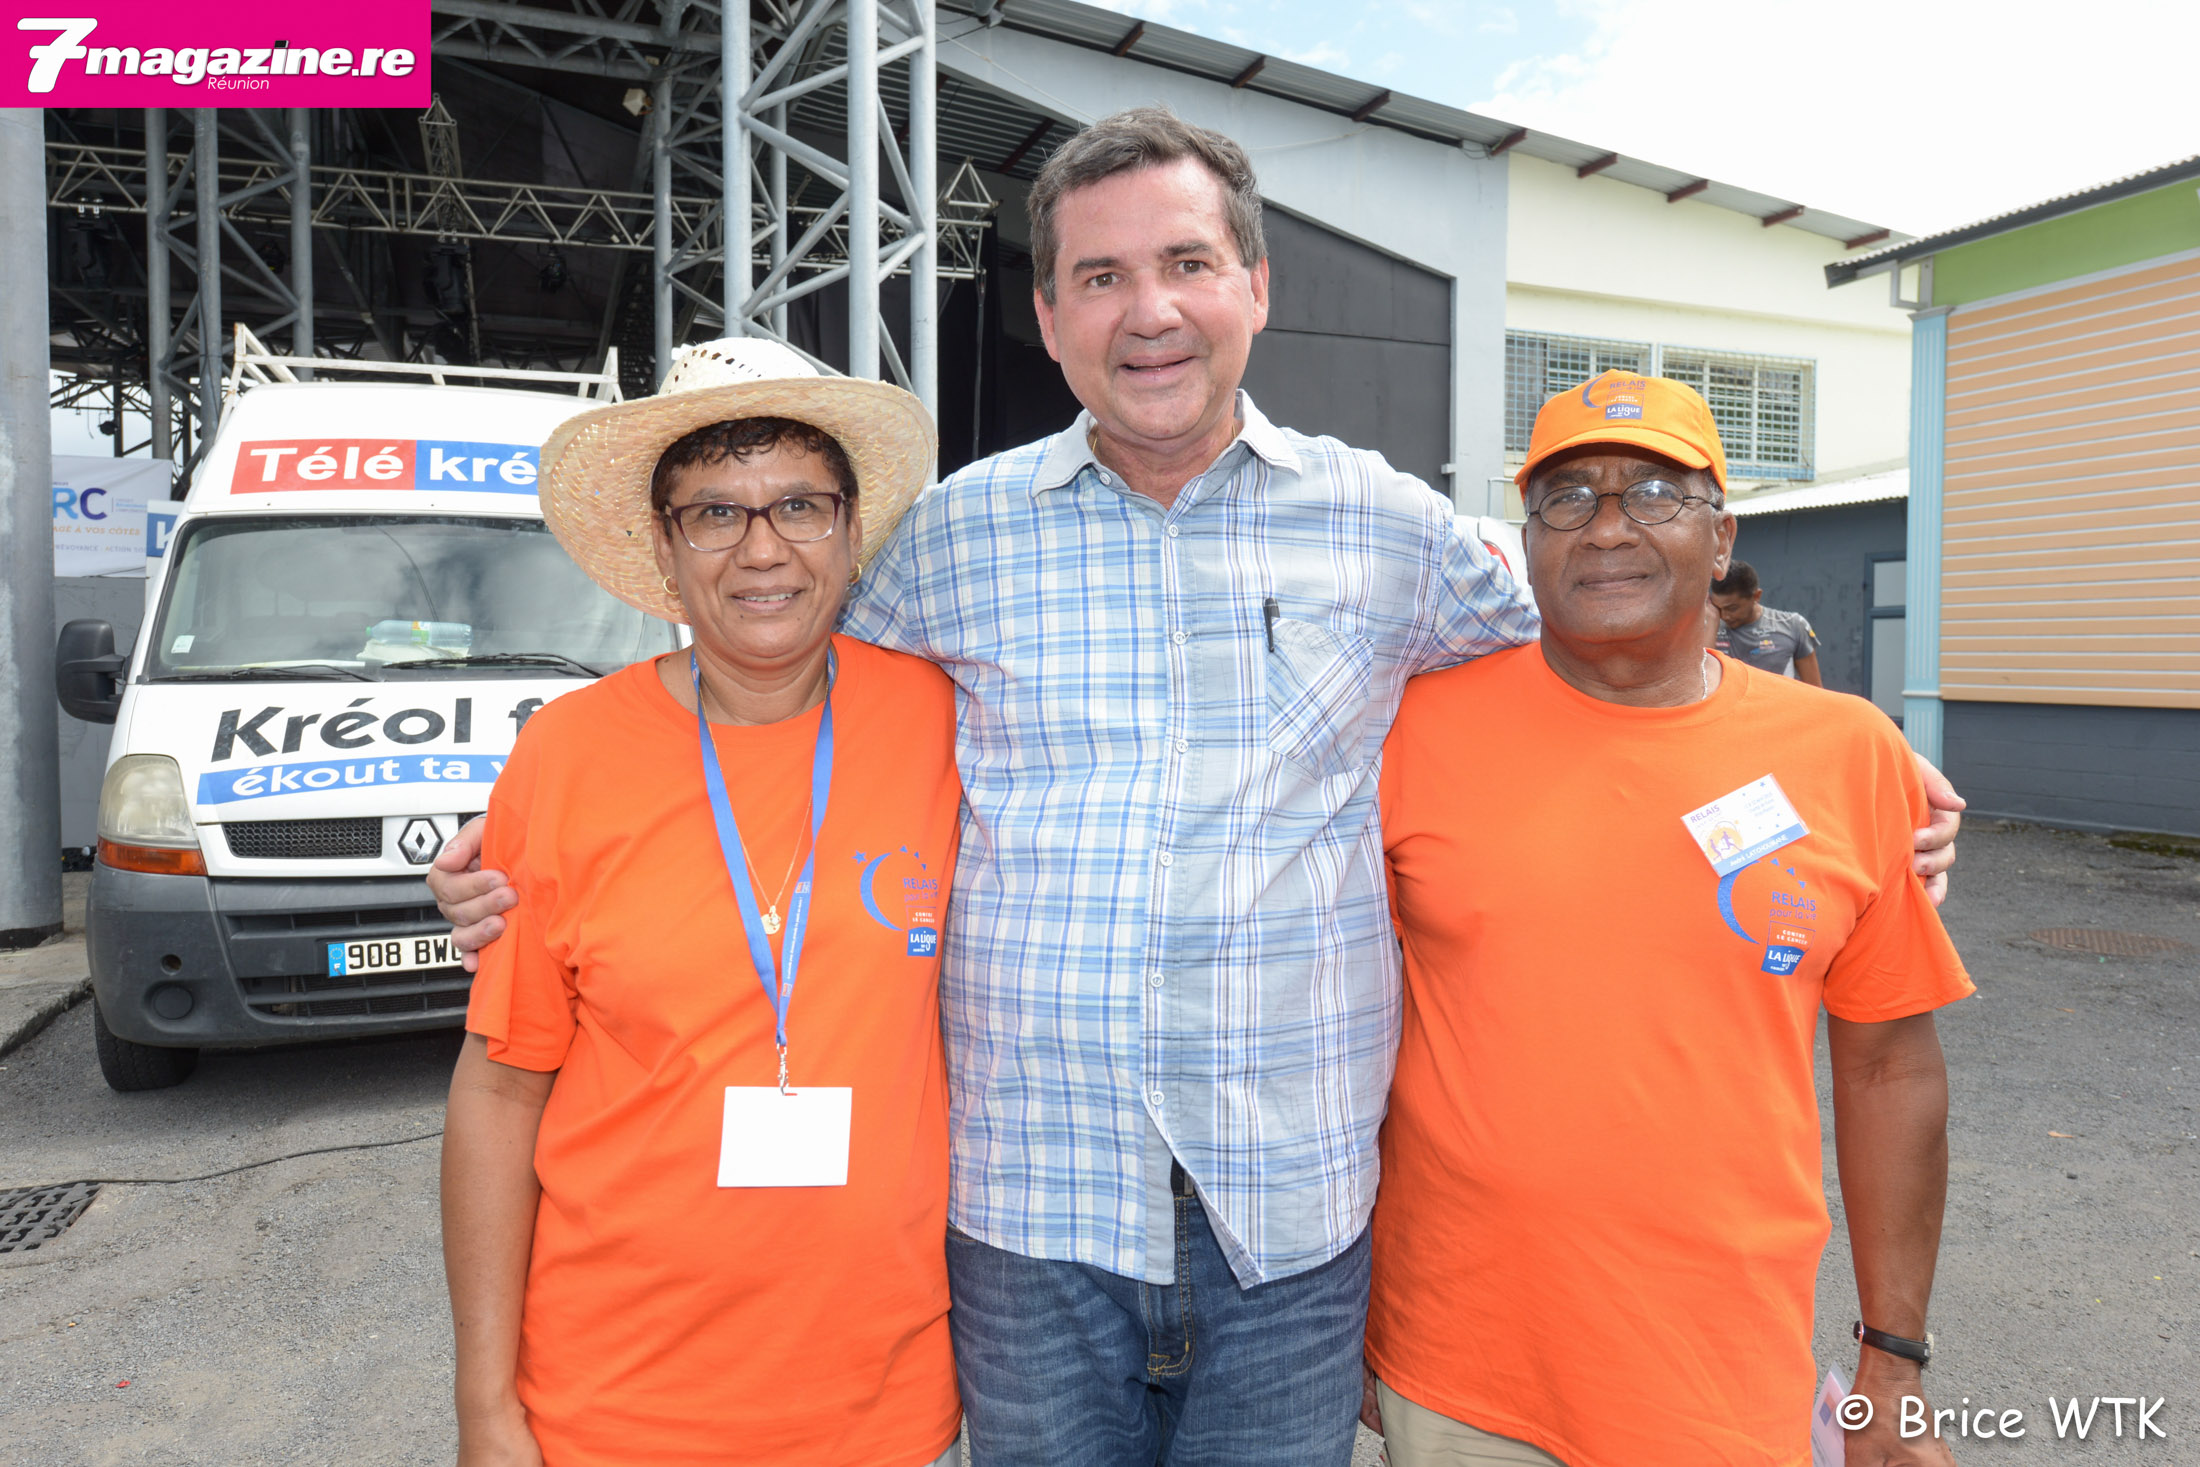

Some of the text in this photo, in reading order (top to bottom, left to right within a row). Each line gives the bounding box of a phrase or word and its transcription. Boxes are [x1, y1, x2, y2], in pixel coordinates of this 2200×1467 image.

[1609, 380, 1646, 389] RELAIS
[250, 446, 537, 485] Télé kré
[211, 697, 472, 763] Kréol
[232, 758, 399, 796] ékout
[420, 758, 470, 780] ta
[1690, 804, 1720, 823] RELAIS
[903, 877, 938, 890] RELAIS
[1771, 891, 1816, 911] RELAIS
[1769, 908, 1792, 918] pour
[1795, 909, 1803, 919] la
[348, 942, 402, 969] 908
[1768, 950, 1781, 961] LA
